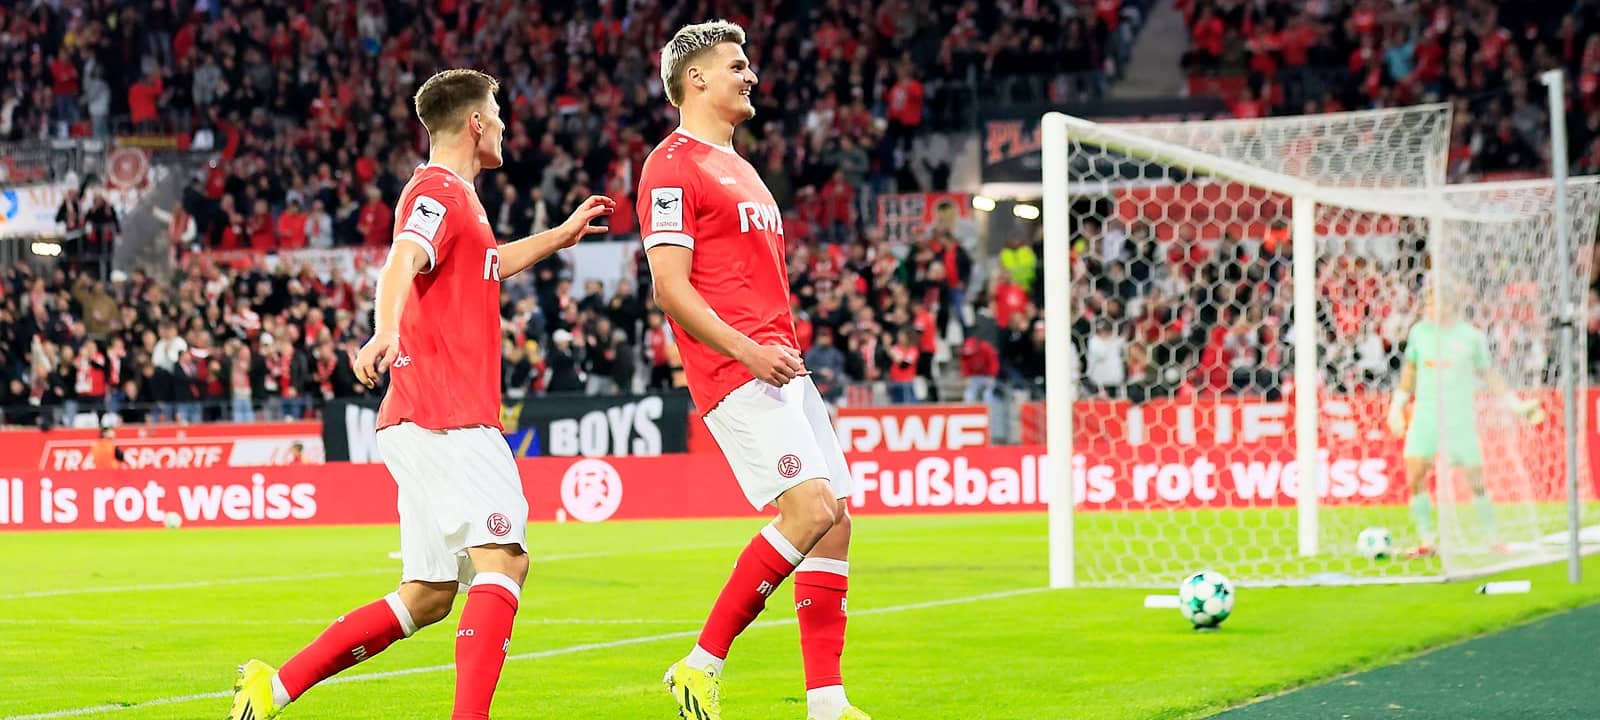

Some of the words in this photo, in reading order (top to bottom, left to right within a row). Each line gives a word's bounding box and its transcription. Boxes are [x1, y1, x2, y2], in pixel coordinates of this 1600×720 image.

[483, 248, 500, 281] R
[549, 396, 664, 458] BOYS
[54, 446, 223, 472] TRASPORTE
[850, 456, 1049, 508] Fußball
[1072, 454, 1116, 504] is
[1132, 457, 1217, 502] rot
[1231, 448, 1388, 500] weiss
[0, 478, 24, 524] ll
[40, 477, 79, 523] is
[93, 480, 165, 522] rot
[178, 473, 317, 521] weiss
